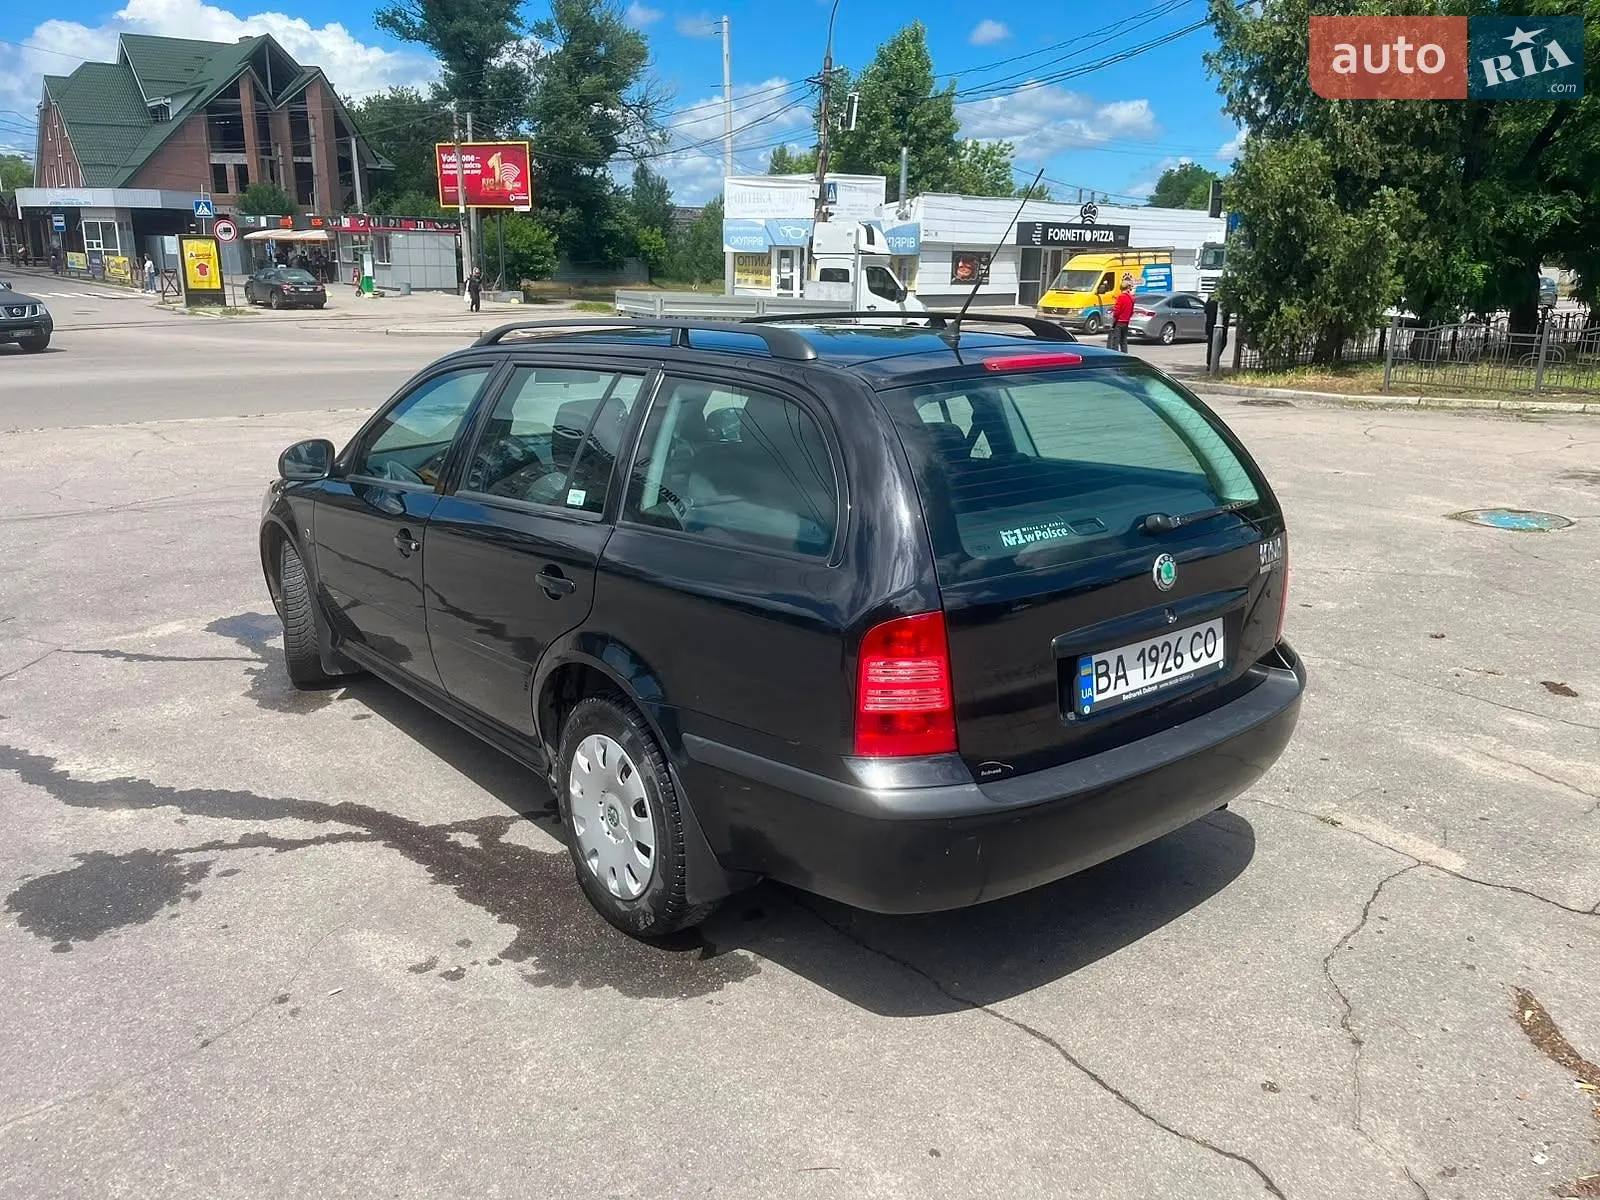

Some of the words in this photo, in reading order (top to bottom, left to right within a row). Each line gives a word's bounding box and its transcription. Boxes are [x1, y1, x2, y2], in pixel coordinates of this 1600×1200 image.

[1047, 228, 1092, 242] FORNETTO
[1092, 230, 1115, 243] PIZZA
[1094, 654, 1130, 695] BA
[1136, 636, 1184, 680] 1926
[1190, 626, 1217, 663] CO
[1081, 687, 1093, 700] UA
